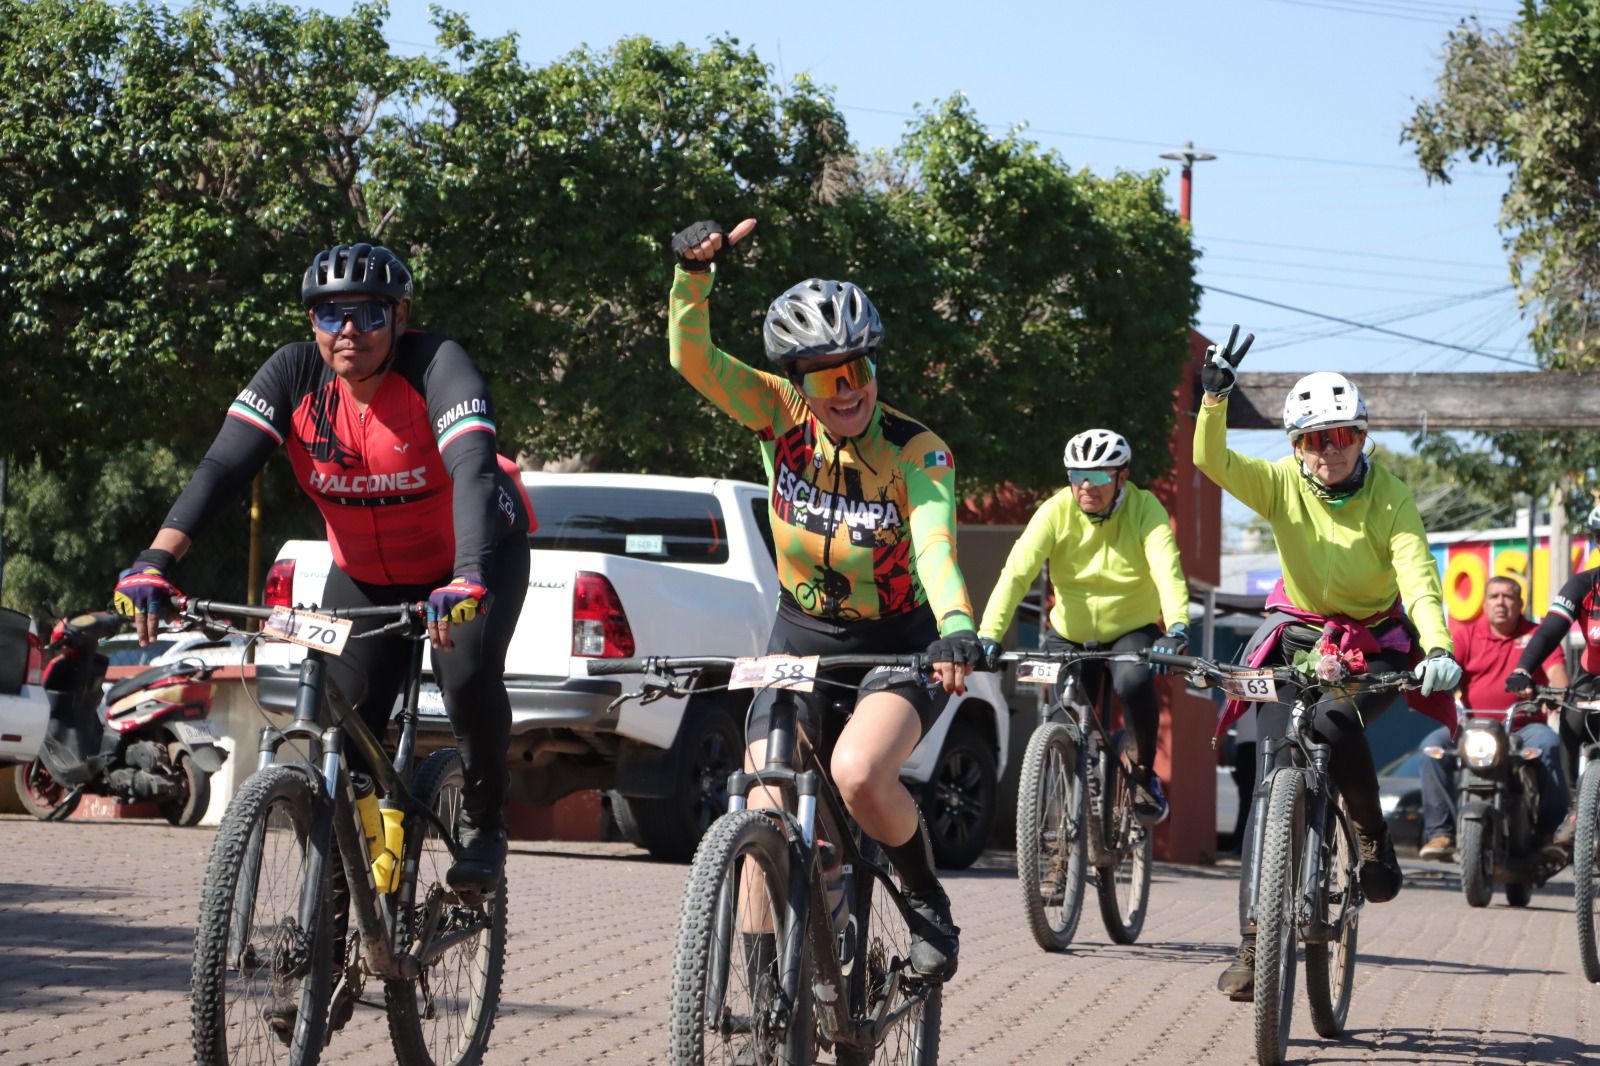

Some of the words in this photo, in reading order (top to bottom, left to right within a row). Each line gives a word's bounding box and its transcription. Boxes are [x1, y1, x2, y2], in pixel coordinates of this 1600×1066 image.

[235, 388, 275, 421] NALOA
[437, 398, 487, 434] SINALOA
[309, 466, 427, 494] HALCONES
[777, 462, 901, 530] ESCUINAPA
[308, 625, 337, 645] 70
[772, 663, 805, 681] 58
[1038, 665, 1052, 677] 61
[1247, 680, 1269, 694] 63
